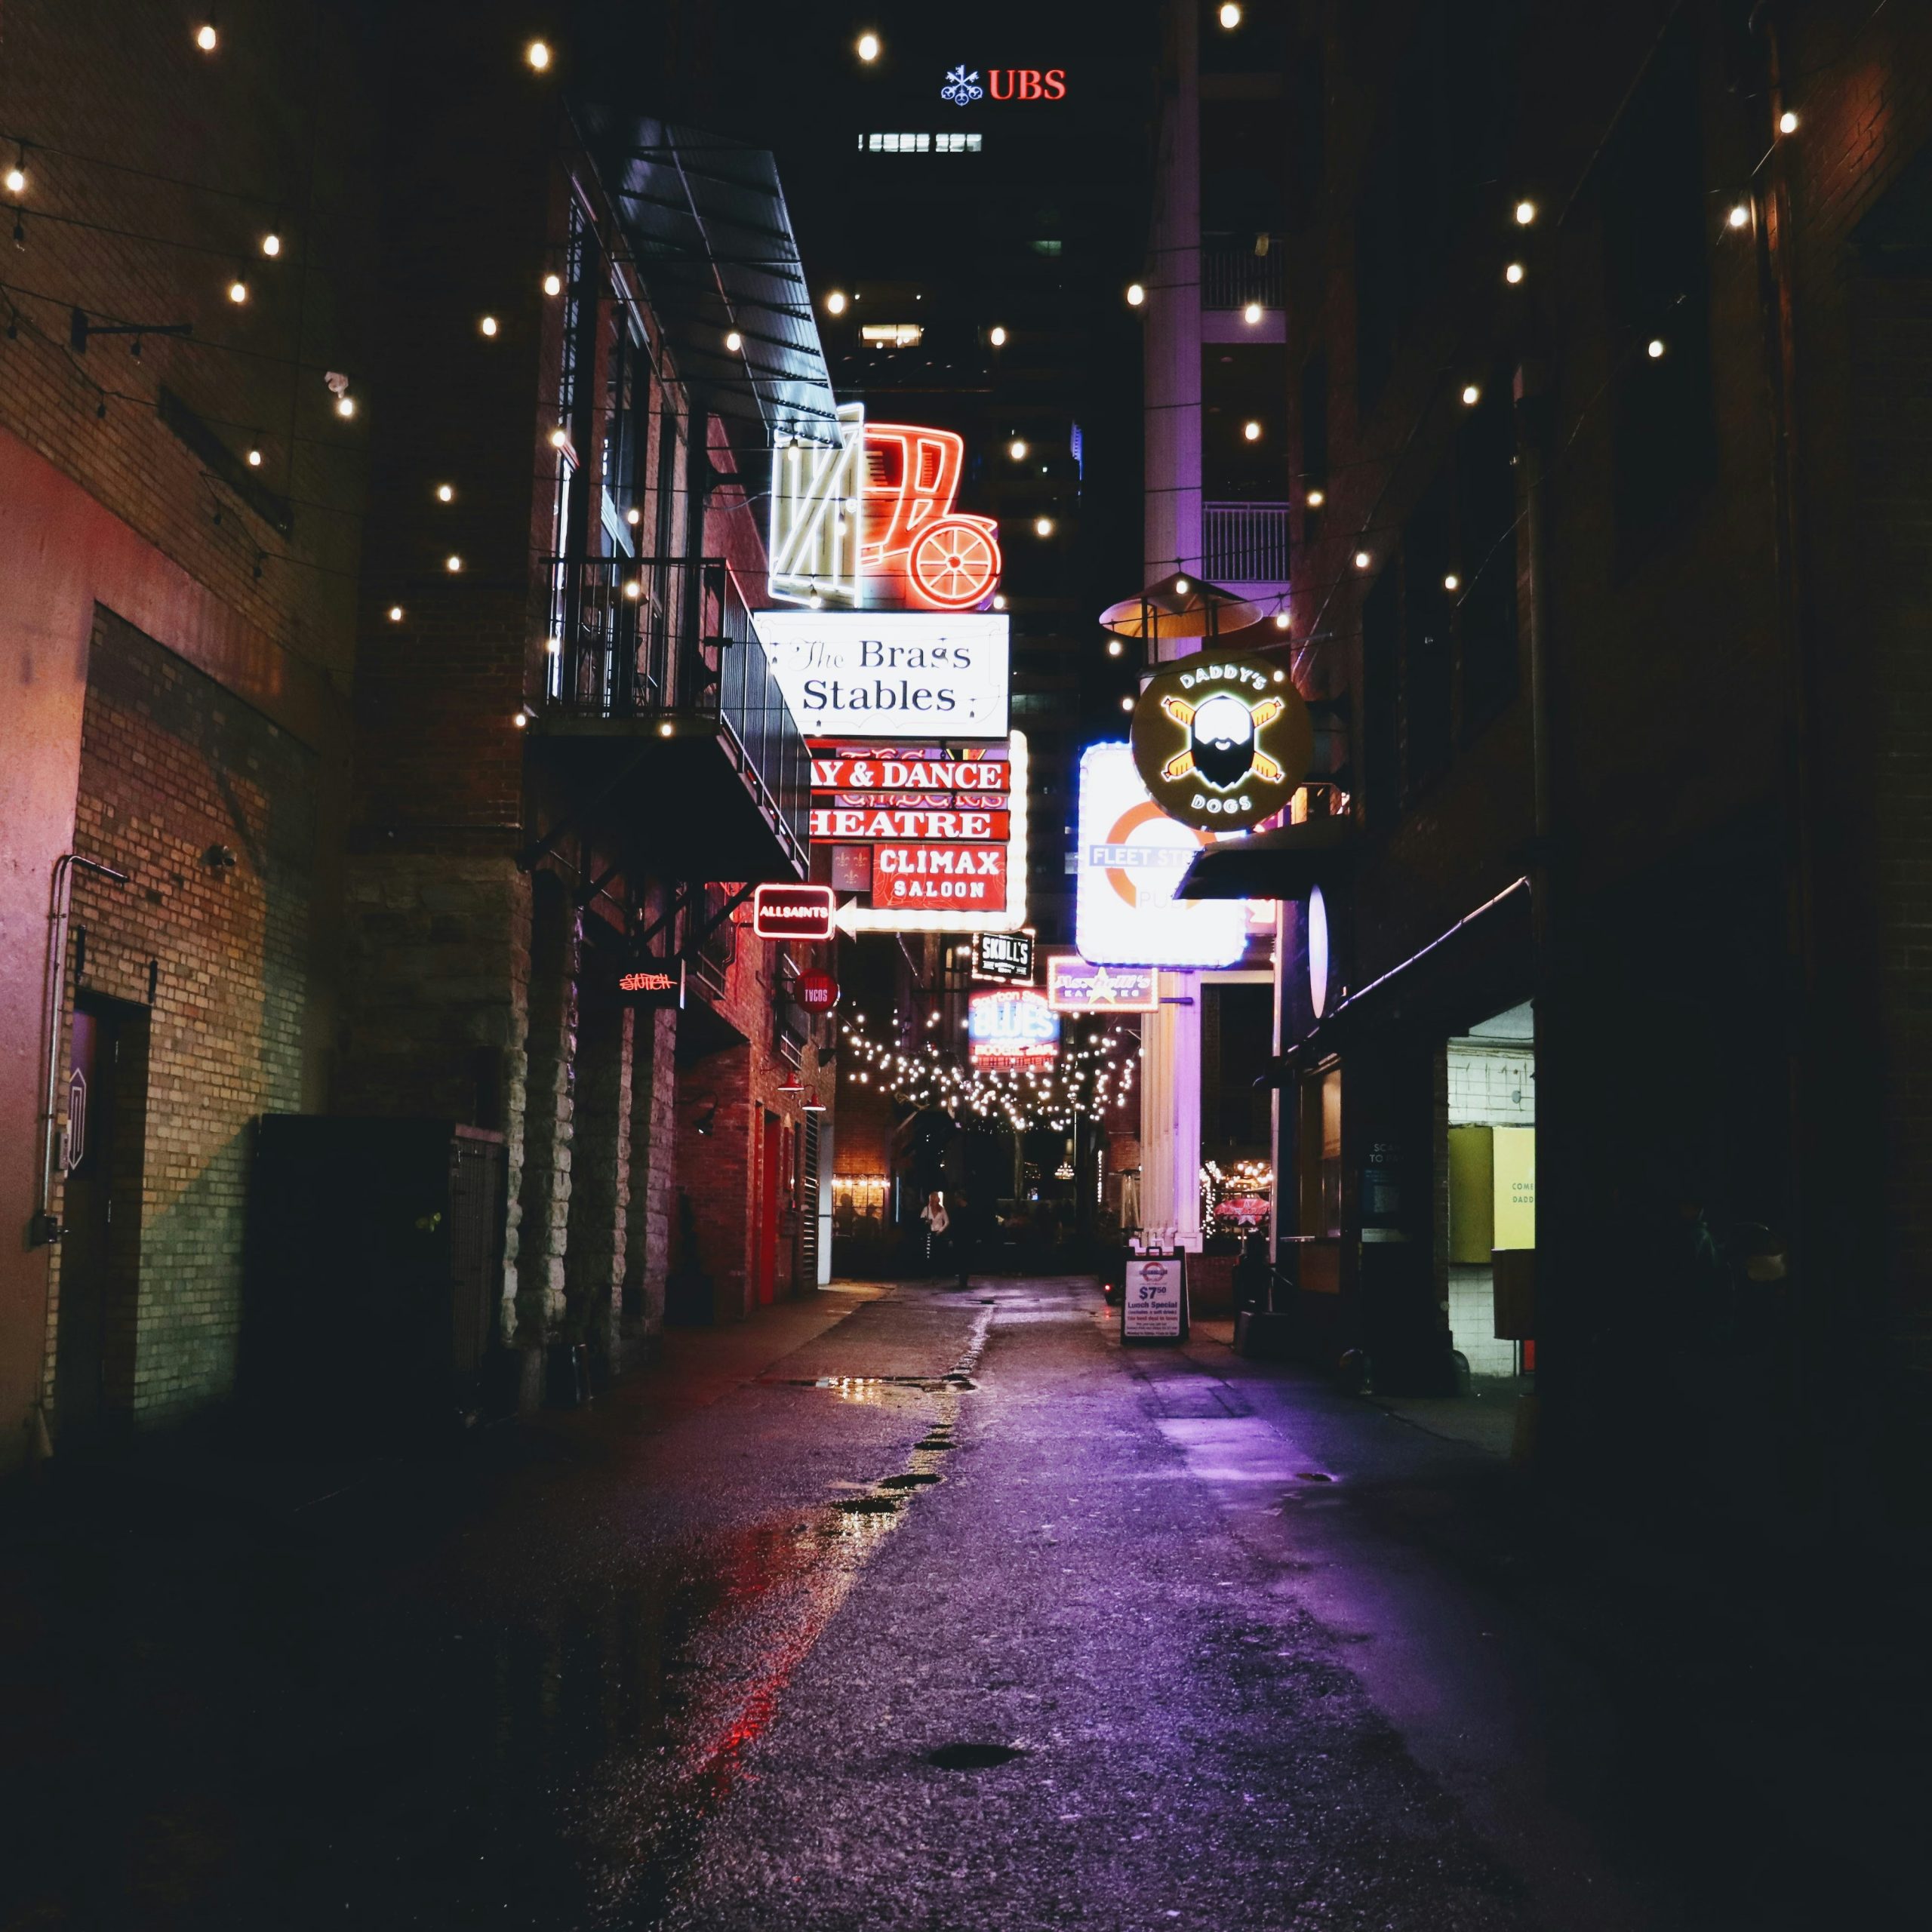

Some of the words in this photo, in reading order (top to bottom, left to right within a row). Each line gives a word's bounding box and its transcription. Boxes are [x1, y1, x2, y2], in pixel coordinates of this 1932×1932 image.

[988, 69, 1066, 100] UBS
[788, 637, 844, 671] The
[859, 639, 971, 669] Brass
[1180, 664, 1267, 691] DADDY'S
[803, 679, 956, 712] Stables
[849, 761, 874, 786] &
[882, 762, 1001, 789] DANCE
[1191, 794, 1252, 814] DOGS
[880, 849, 1000, 875] CLIMAX
[1093, 848, 1152, 865] FLEET
[894, 881, 985, 898] SALOON
[759, 905, 829, 918] ALLSAINTS
[982, 937, 1029, 965] SKULL'S
[974, 1001, 1054, 1038] BLUES
[1369, 1154, 1383, 1163] TO
